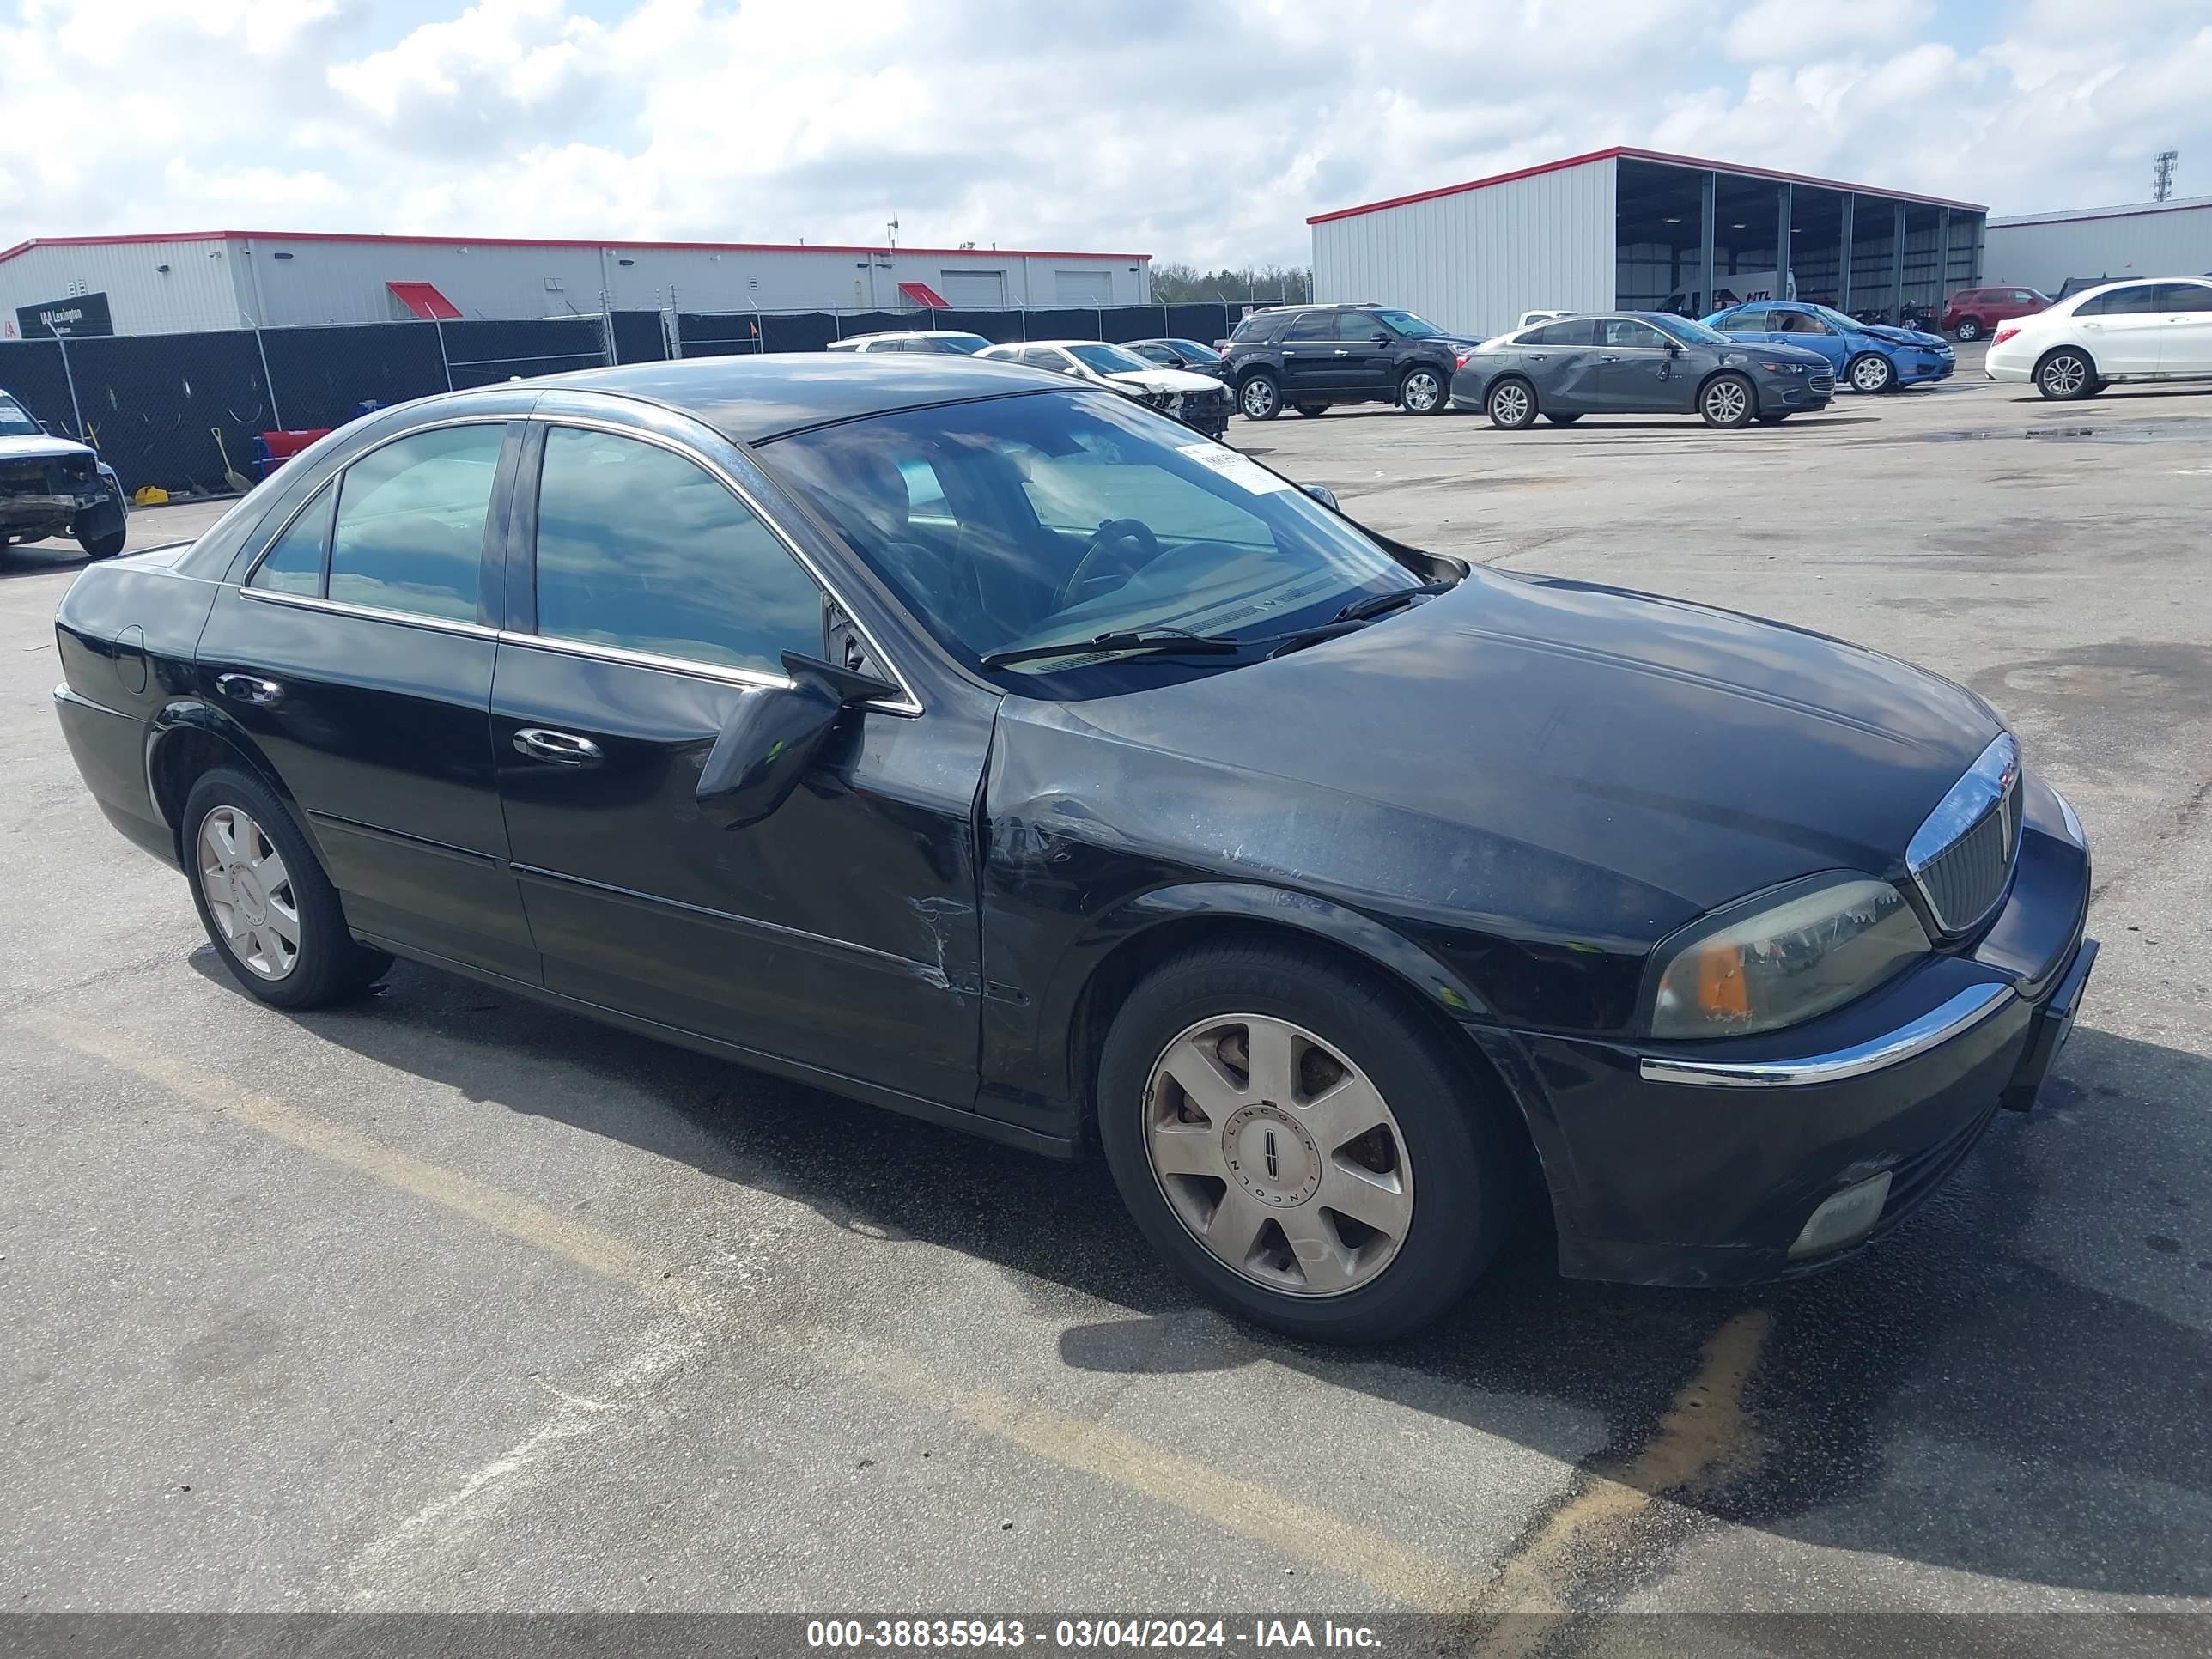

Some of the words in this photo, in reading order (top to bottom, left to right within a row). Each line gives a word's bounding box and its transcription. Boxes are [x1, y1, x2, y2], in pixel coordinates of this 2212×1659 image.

[52, 308, 82, 323] Lexington
[1228, 1109, 1313, 1152] LINCOLN
[1231, 1160, 1316, 1203] LINCOLN
